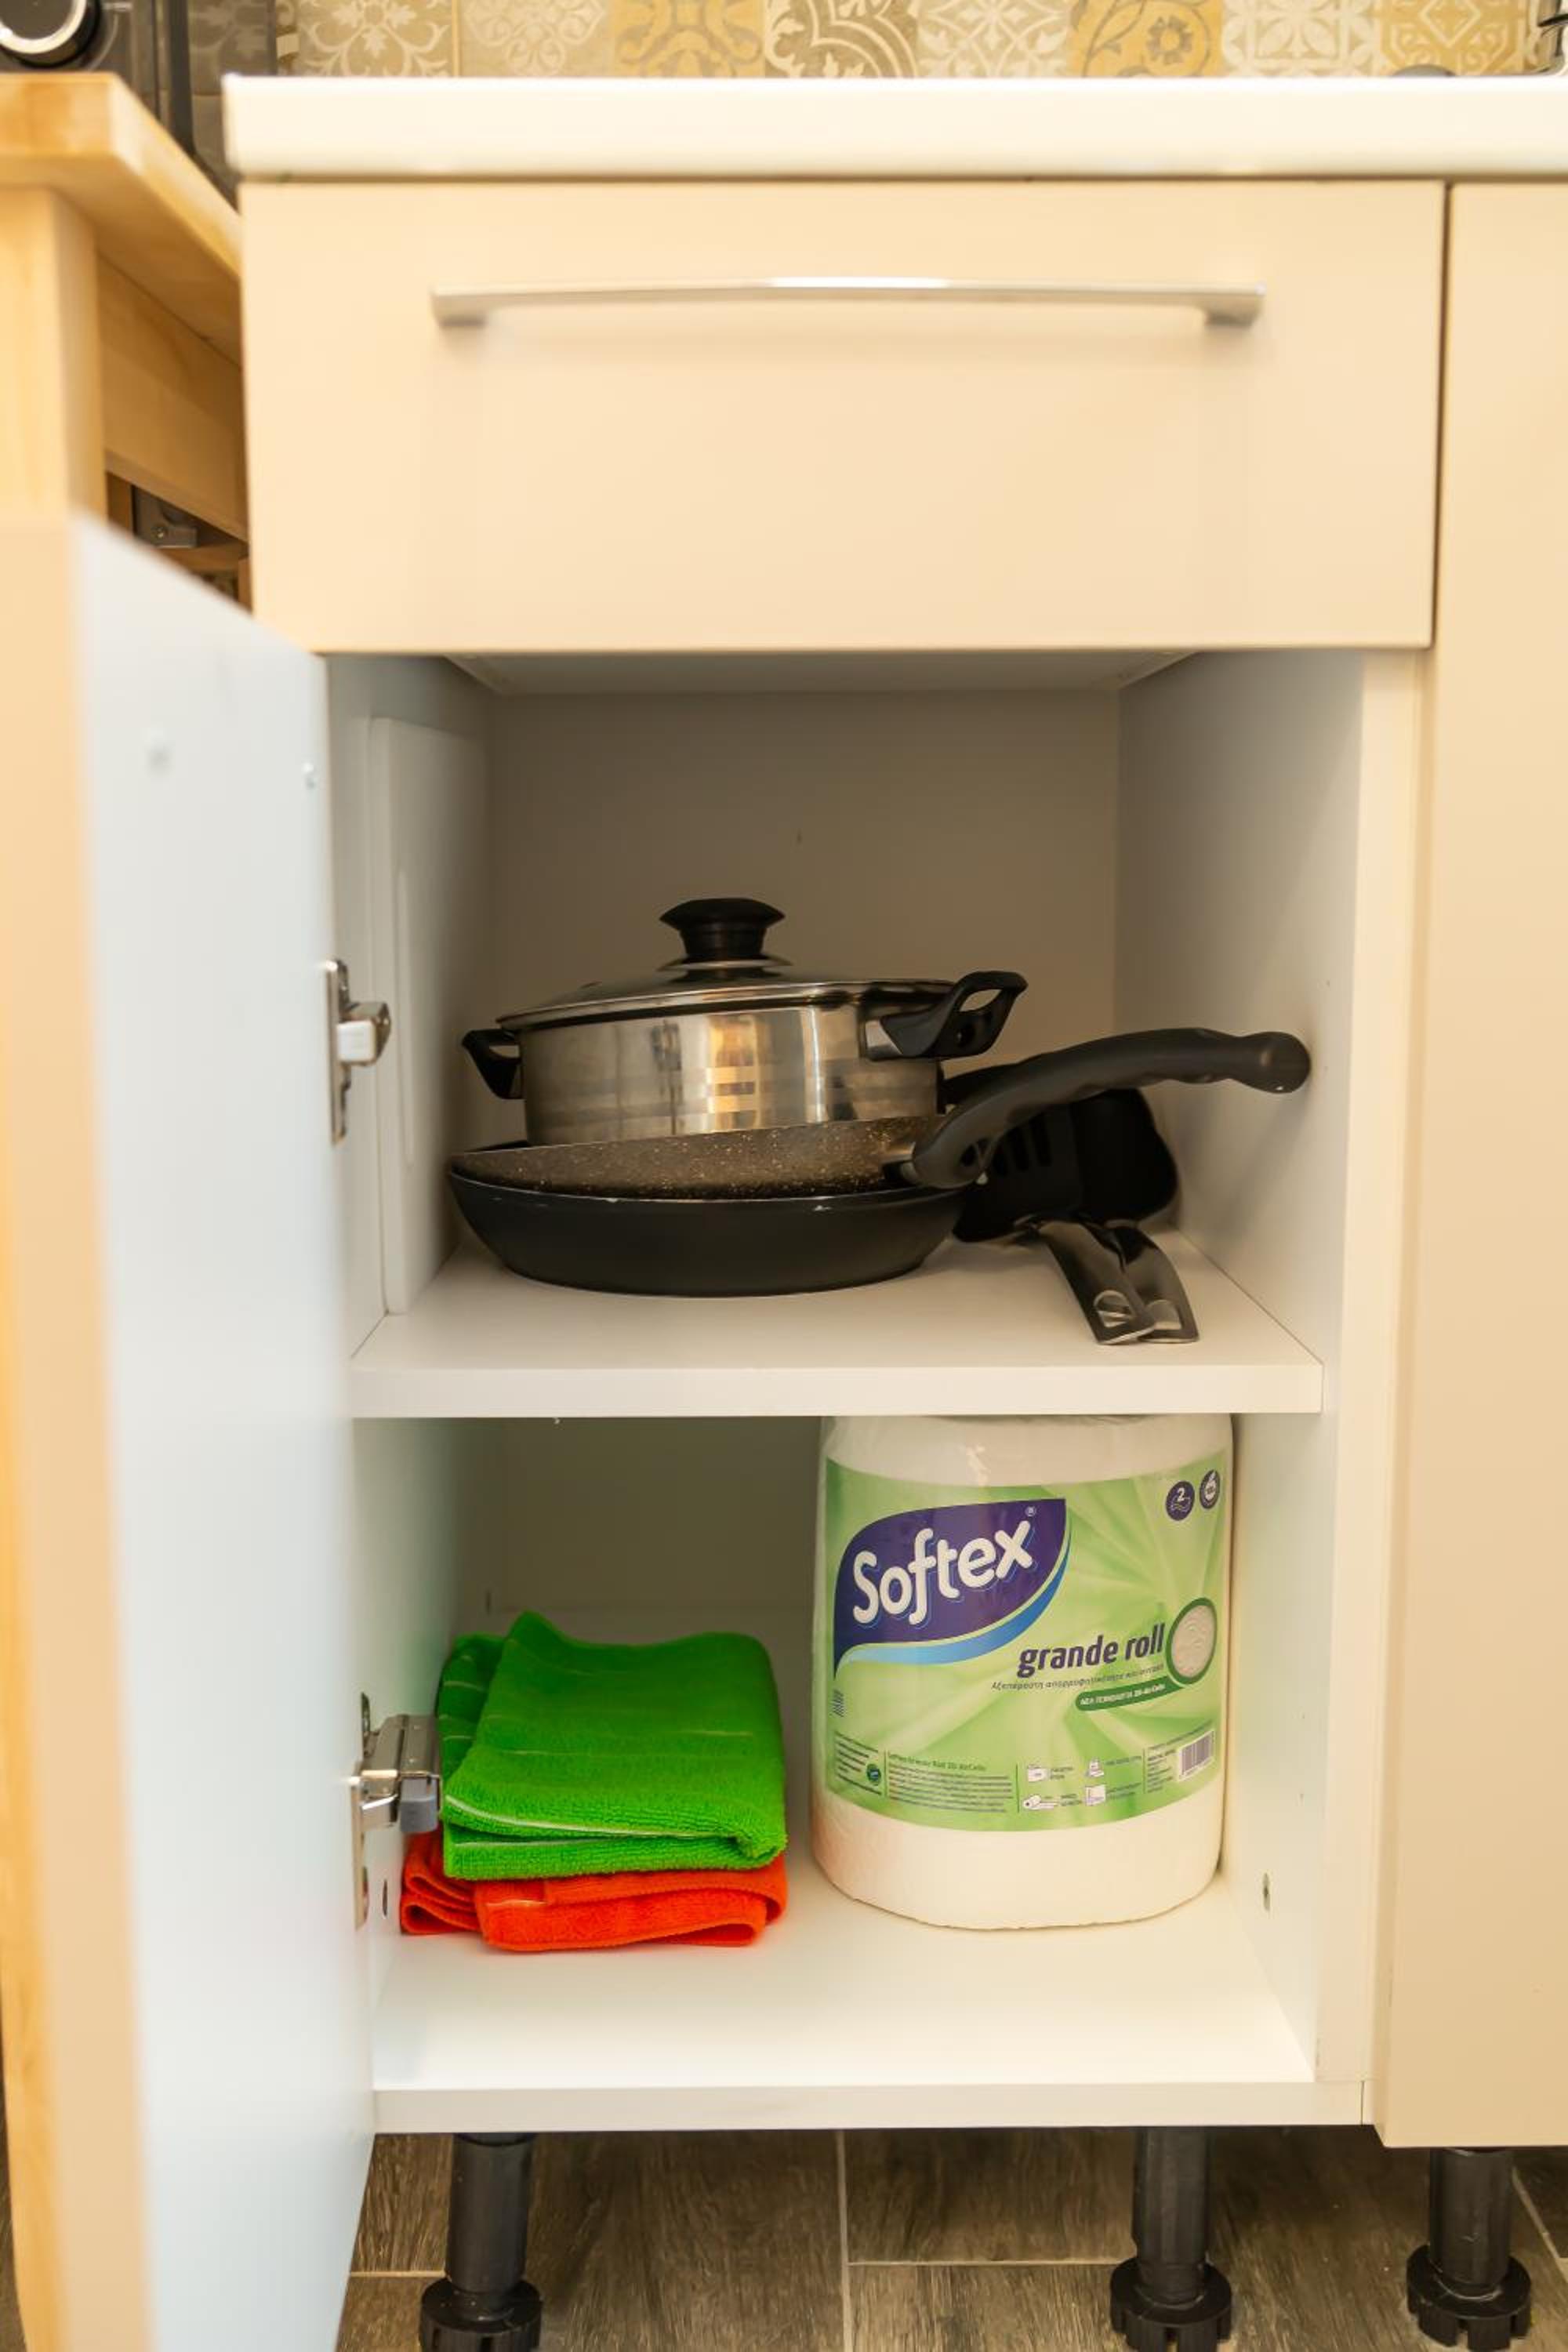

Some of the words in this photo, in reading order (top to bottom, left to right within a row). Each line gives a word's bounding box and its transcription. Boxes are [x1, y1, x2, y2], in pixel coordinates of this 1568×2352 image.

[1177, 1487, 1185, 1502] 2
[852, 1520, 1033, 1625] Softex
[1017, 1634, 1119, 1679] grande
[1124, 1622, 1166, 1661] roll
